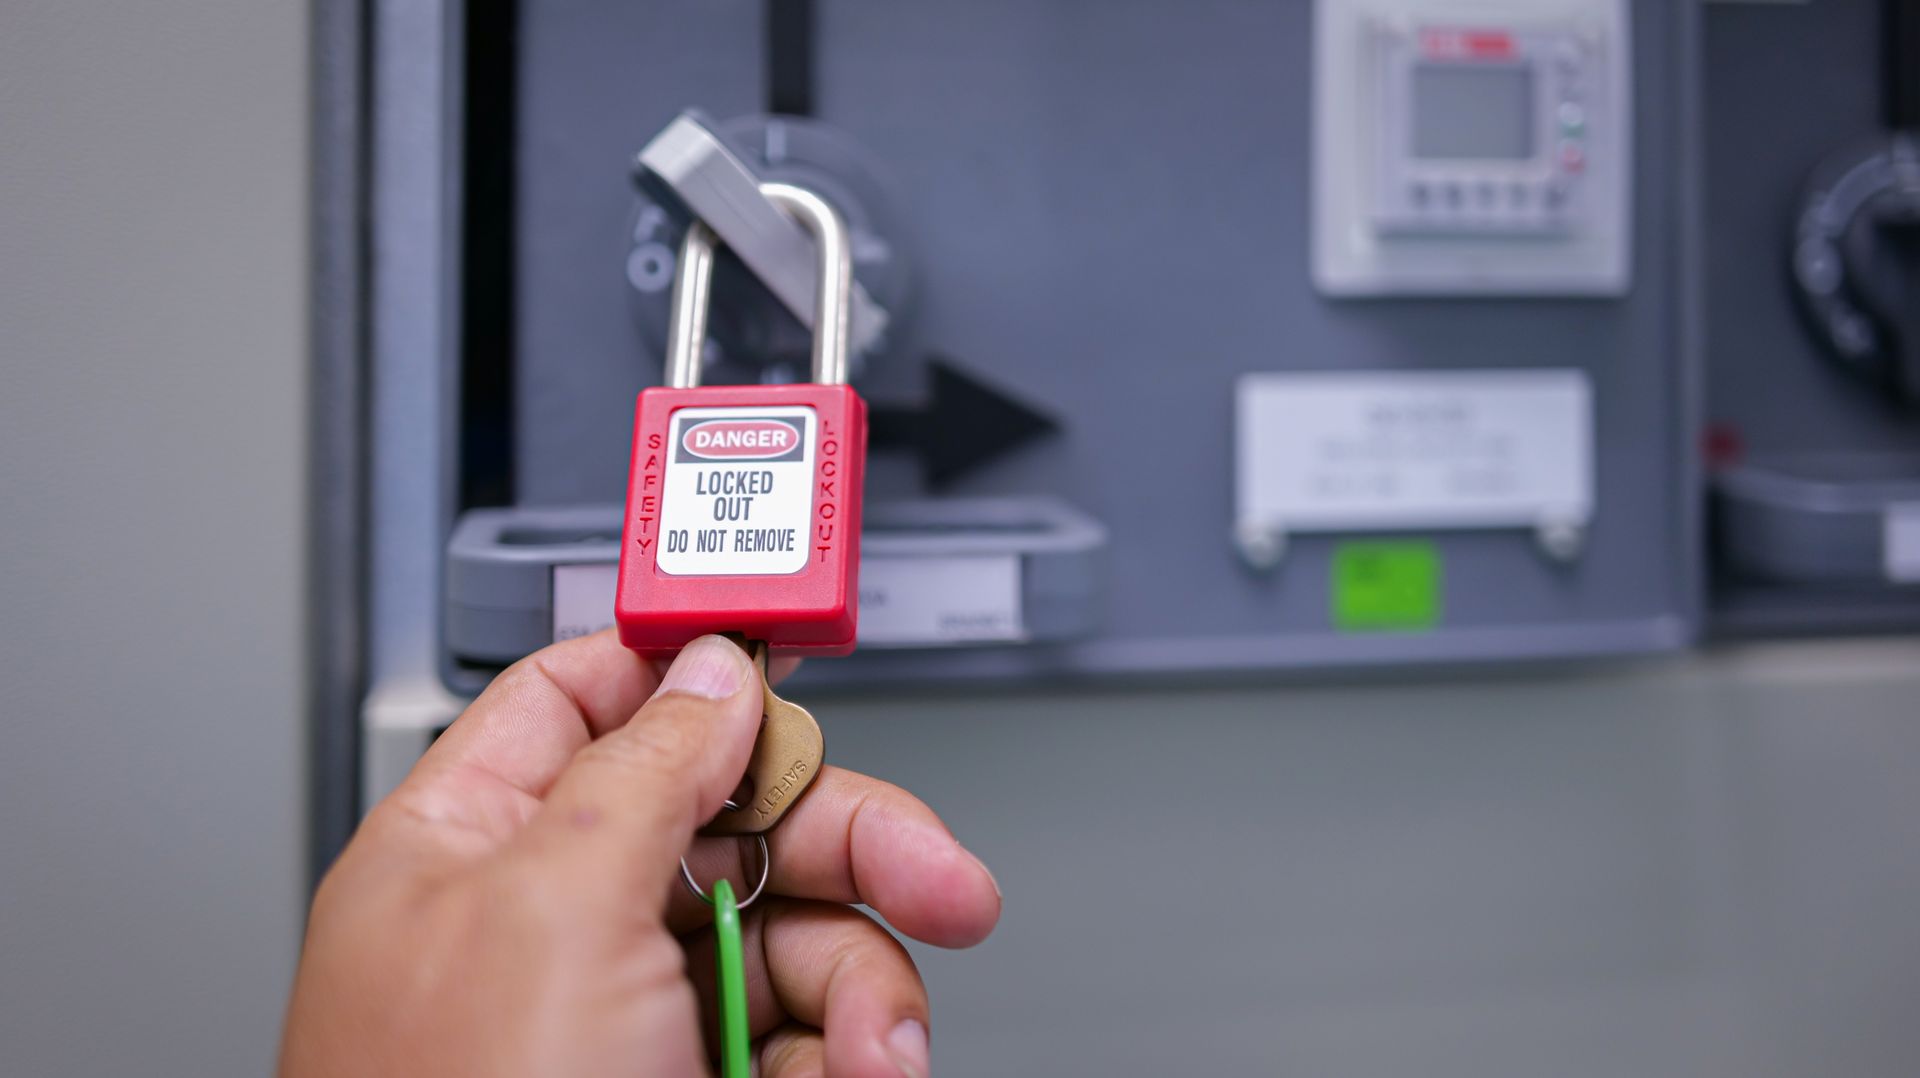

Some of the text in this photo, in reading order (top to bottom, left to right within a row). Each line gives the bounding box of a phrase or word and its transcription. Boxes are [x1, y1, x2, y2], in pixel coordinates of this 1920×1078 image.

[694, 429, 788, 448] DANGER
[637, 434, 661, 556] SAFETY
[696, 471, 774, 495] LOCKED
[817, 420, 838, 562] LOCKOUT
[713, 497, 754, 521] OUT
[667, 529, 796, 553] DO NOT REMOVE
[755, 759, 808, 822] SAFETY
